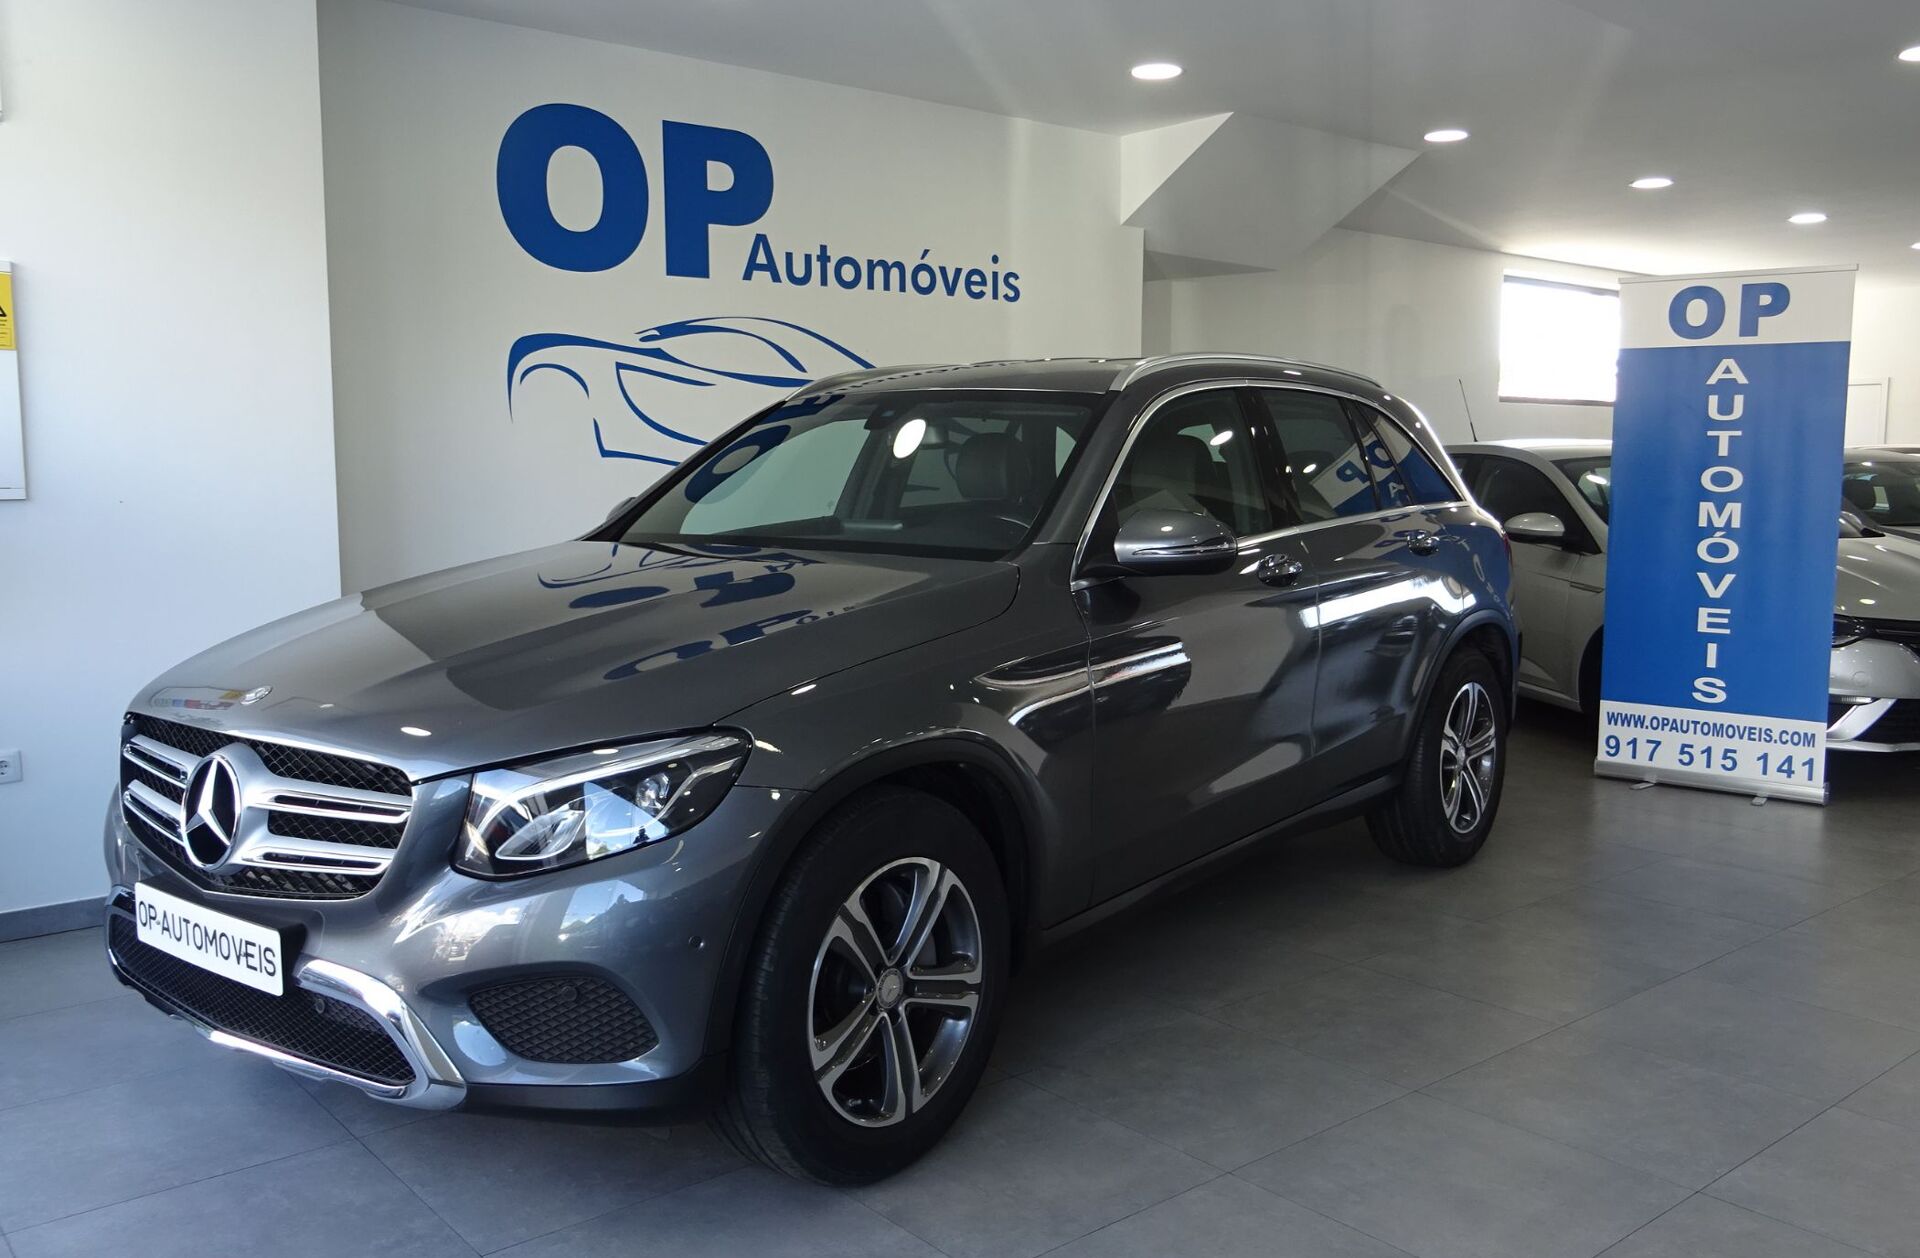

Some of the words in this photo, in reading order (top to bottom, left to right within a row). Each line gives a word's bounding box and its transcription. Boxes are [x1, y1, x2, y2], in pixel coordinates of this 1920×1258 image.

[497, 103, 774, 279] OP
[742, 234, 1021, 303] Automóveis
[1668, 282, 1791, 340] OP
[1691, 358, 1749, 704] AUTOMÓVEIS
[1604, 734, 1662, 763] 917
[1677, 742, 1738, 772] 515
[1756, 751, 1815, 782] 141
[1606, 711, 1816, 748] WWW.OPAUTOMOVEIS.COM
